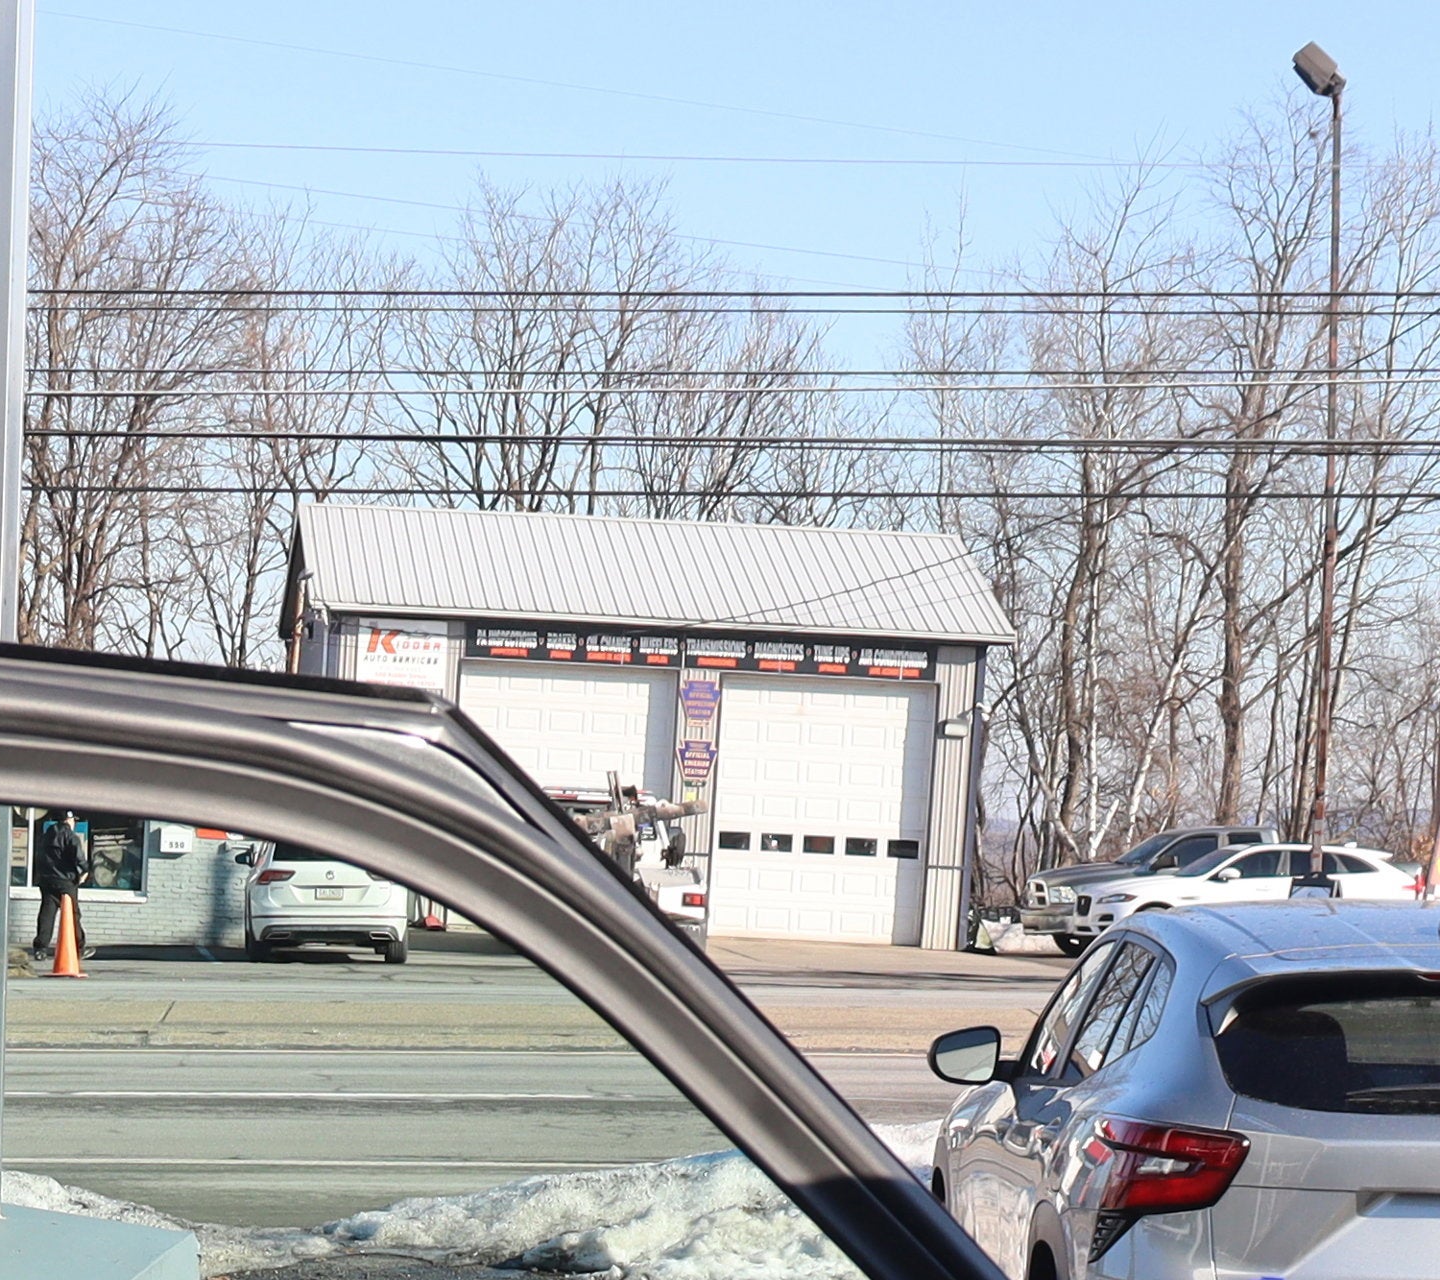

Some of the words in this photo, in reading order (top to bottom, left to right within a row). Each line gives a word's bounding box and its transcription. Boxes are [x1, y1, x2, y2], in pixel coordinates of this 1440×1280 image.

[363, 655, 388, 663] AUTO
[392, 656, 439, 665] SERVICES
[684, 751, 710, 759] OFFICIAL
